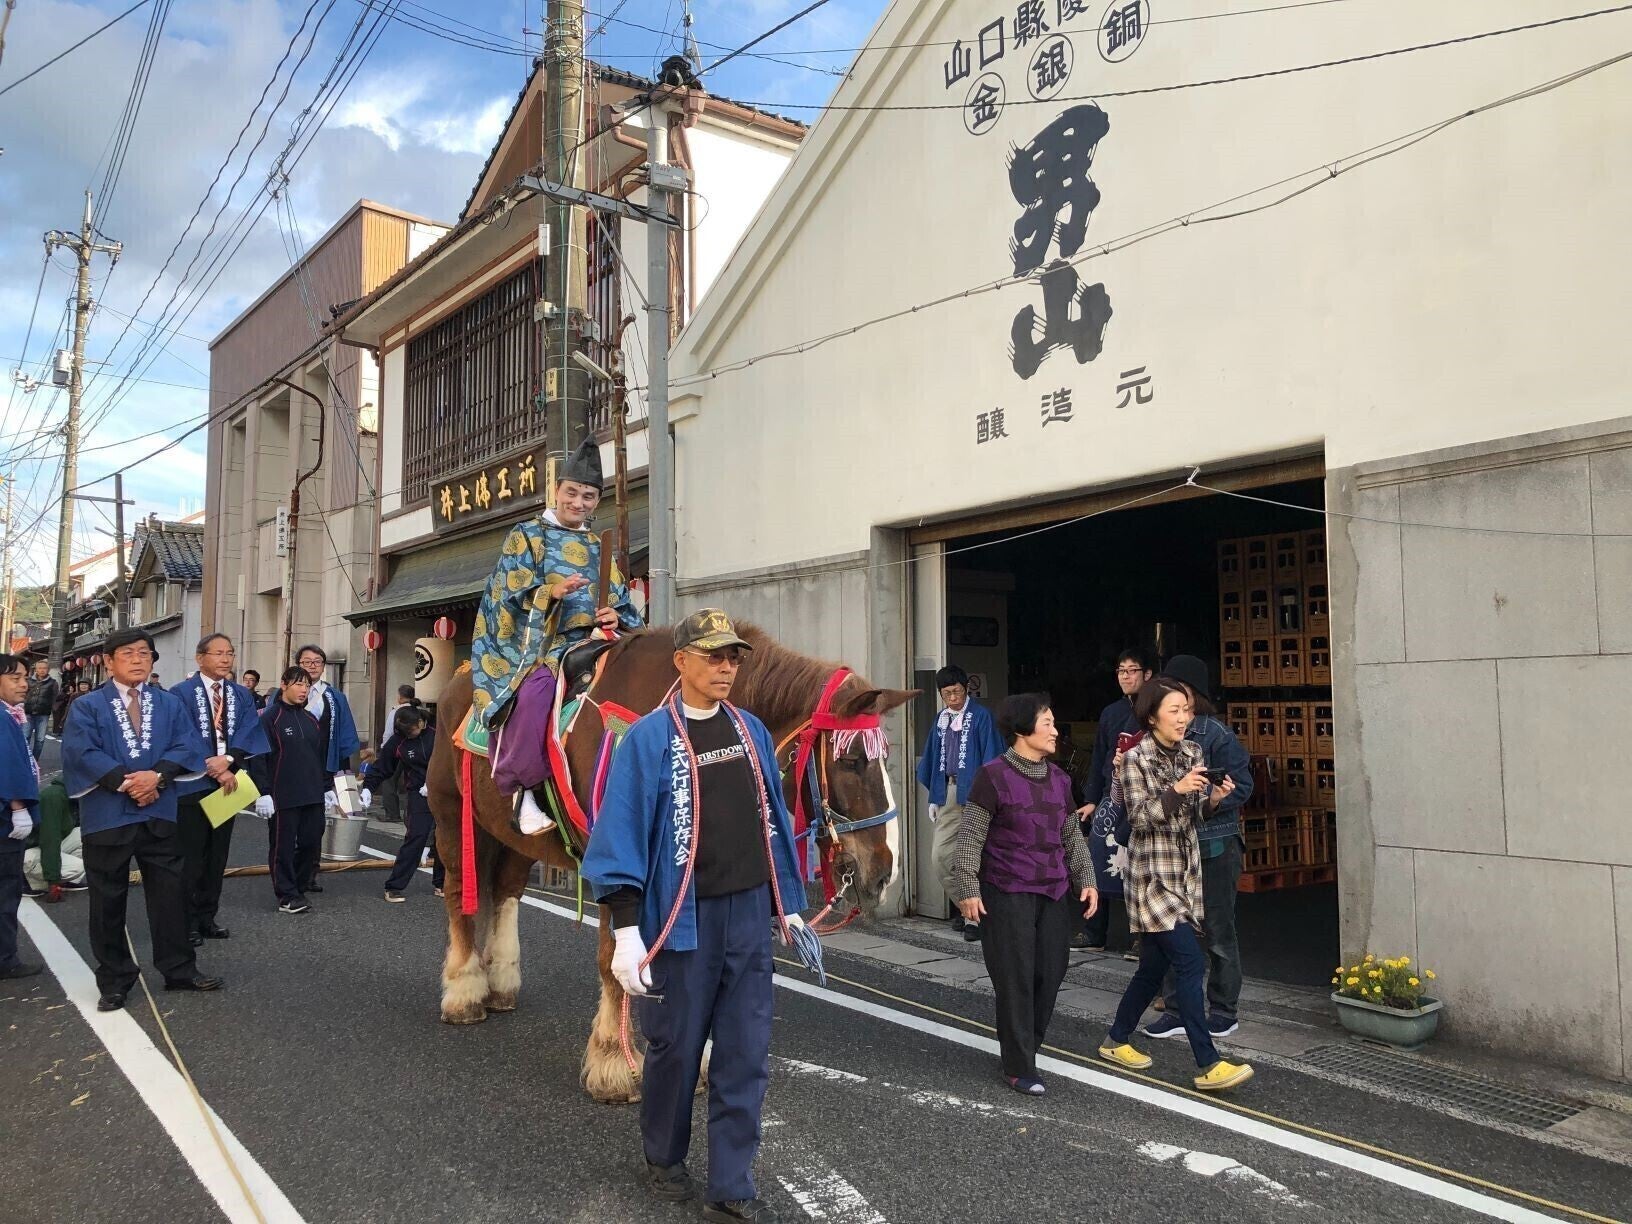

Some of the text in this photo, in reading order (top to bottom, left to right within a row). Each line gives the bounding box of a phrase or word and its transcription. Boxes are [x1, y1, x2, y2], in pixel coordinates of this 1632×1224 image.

[969, 1, 1142, 130] 金 銀 銅
[1005, 100, 1113, 380] 男山
[671, 734, 692, 867] 古式行事保存会
[696, 744, 744, 763] FIRSTDOW
